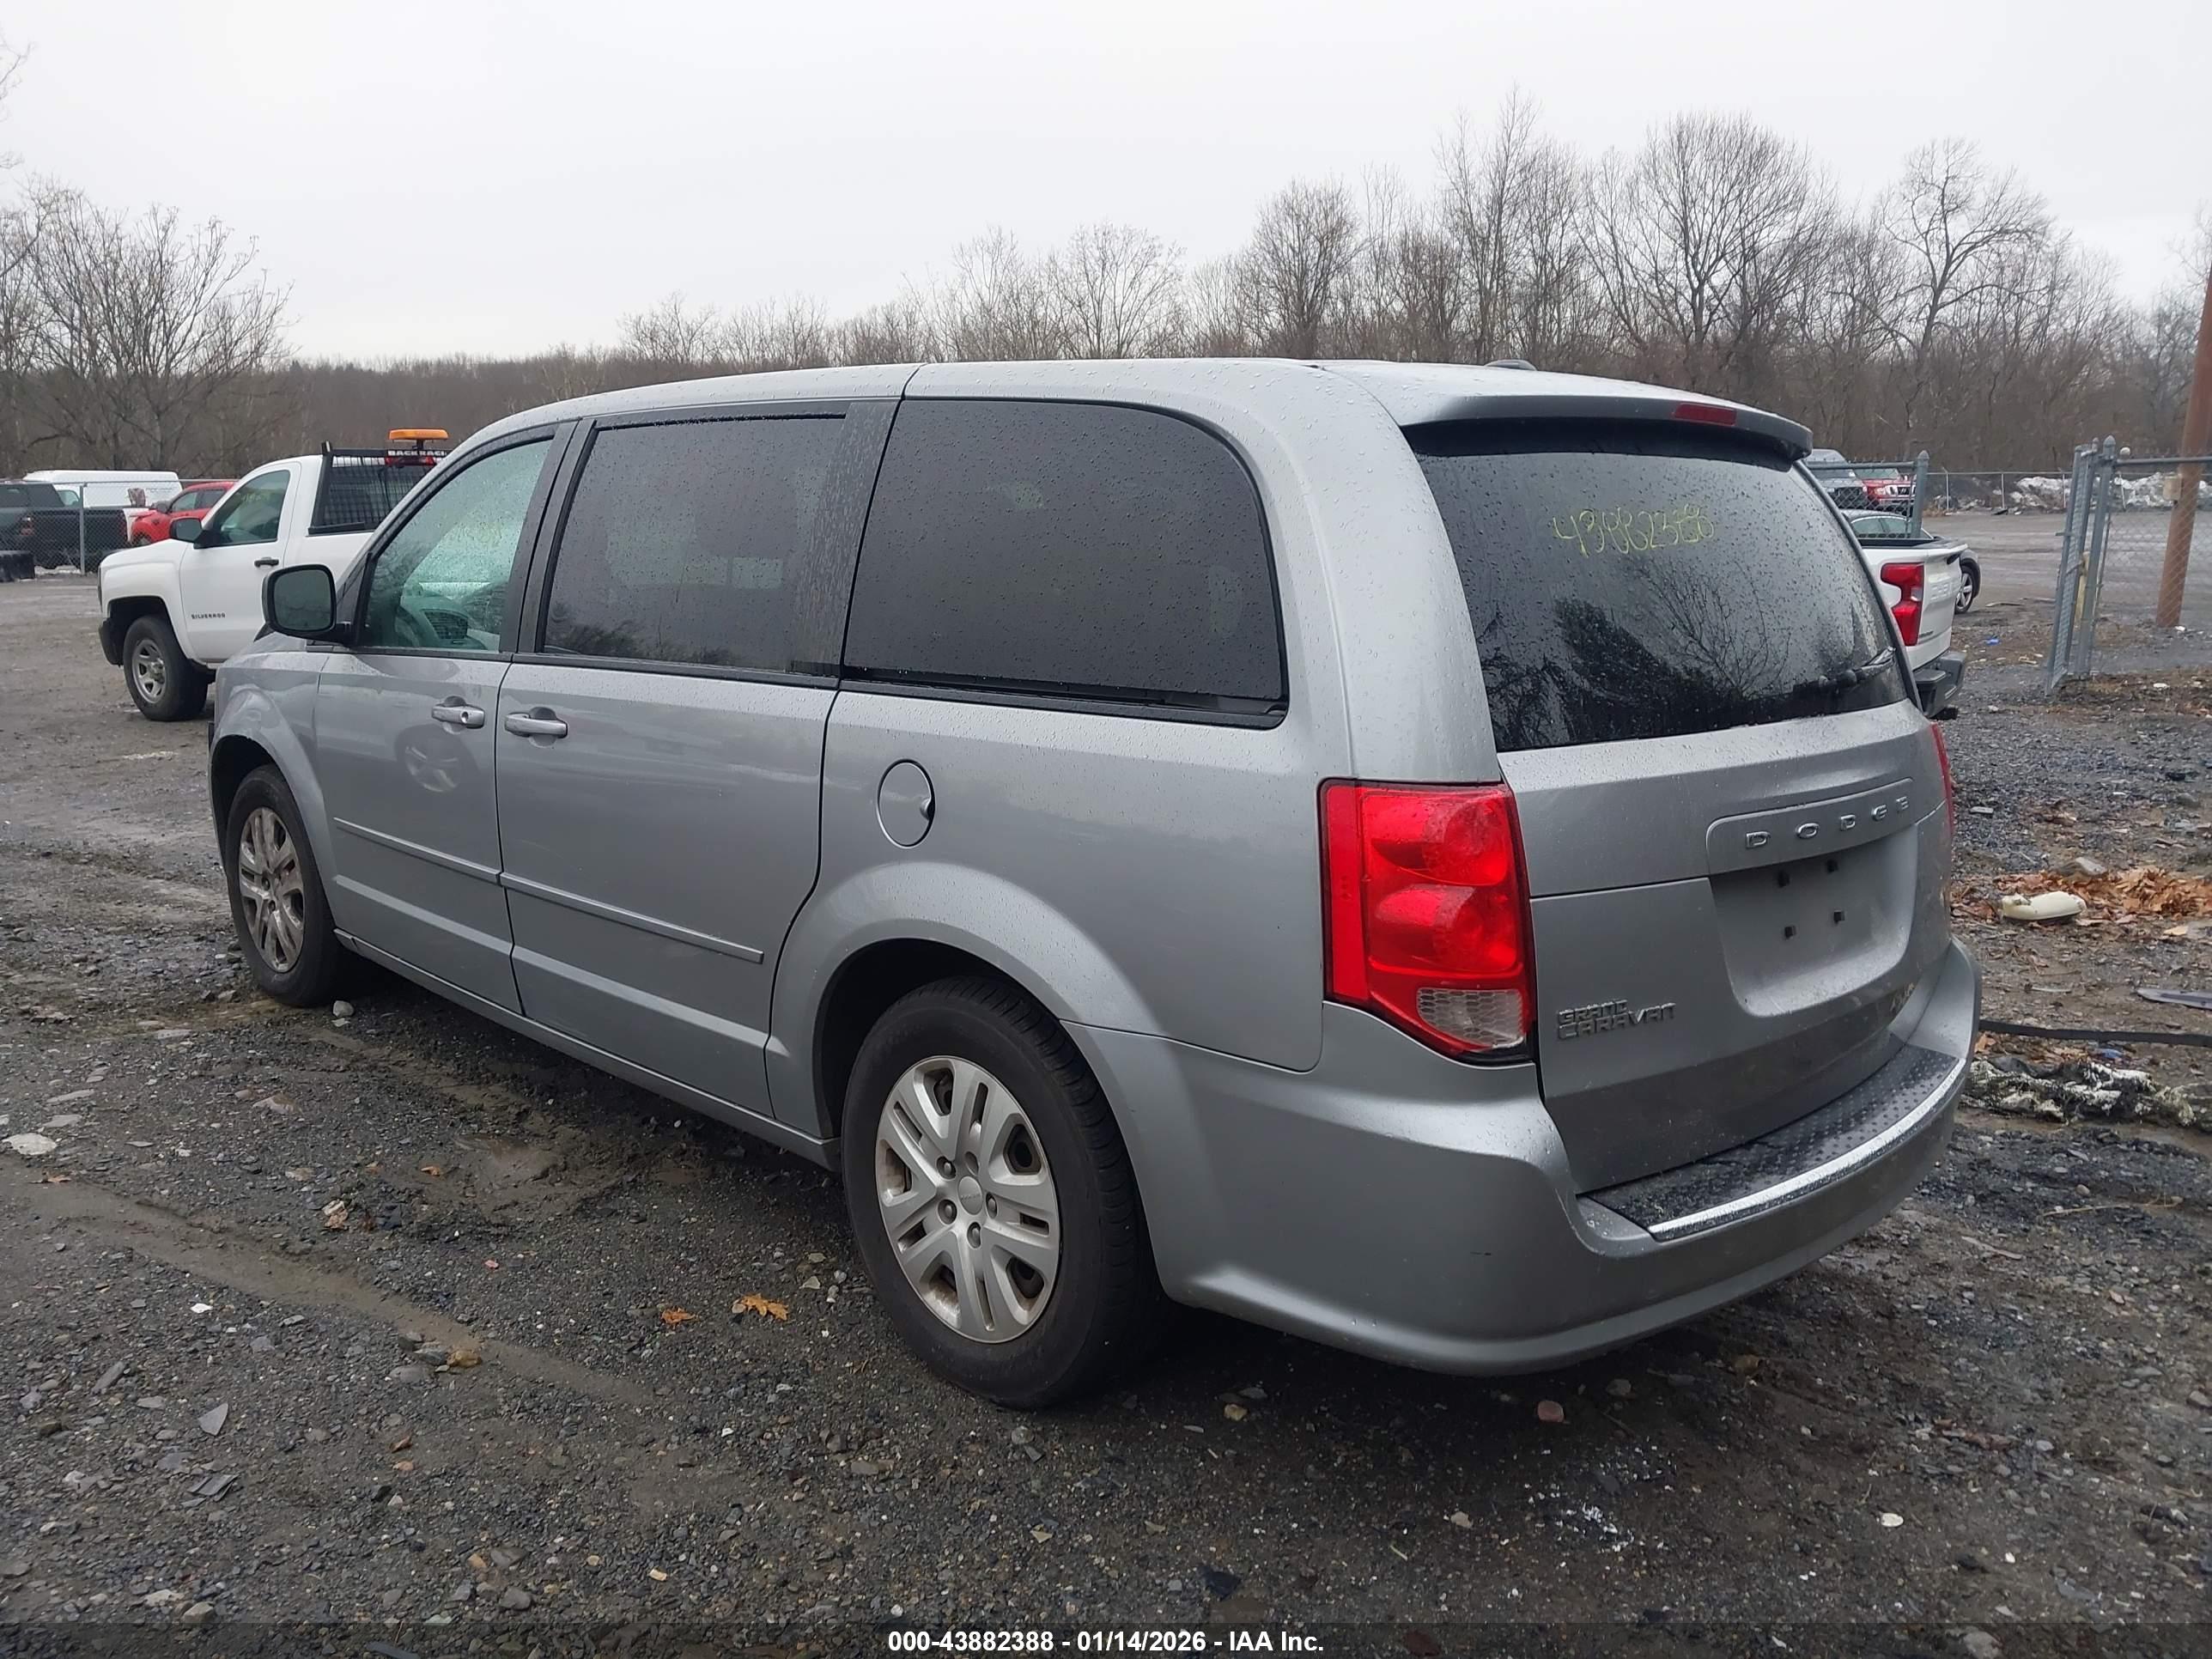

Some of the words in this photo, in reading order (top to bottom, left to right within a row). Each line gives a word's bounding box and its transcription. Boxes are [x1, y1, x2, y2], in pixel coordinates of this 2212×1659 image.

[1746, 797, 1909, 848] DODGE
[1558, 1002, 1676, 1040] CARAVAN
[1559, 999, 1628, 1024] GRAND
